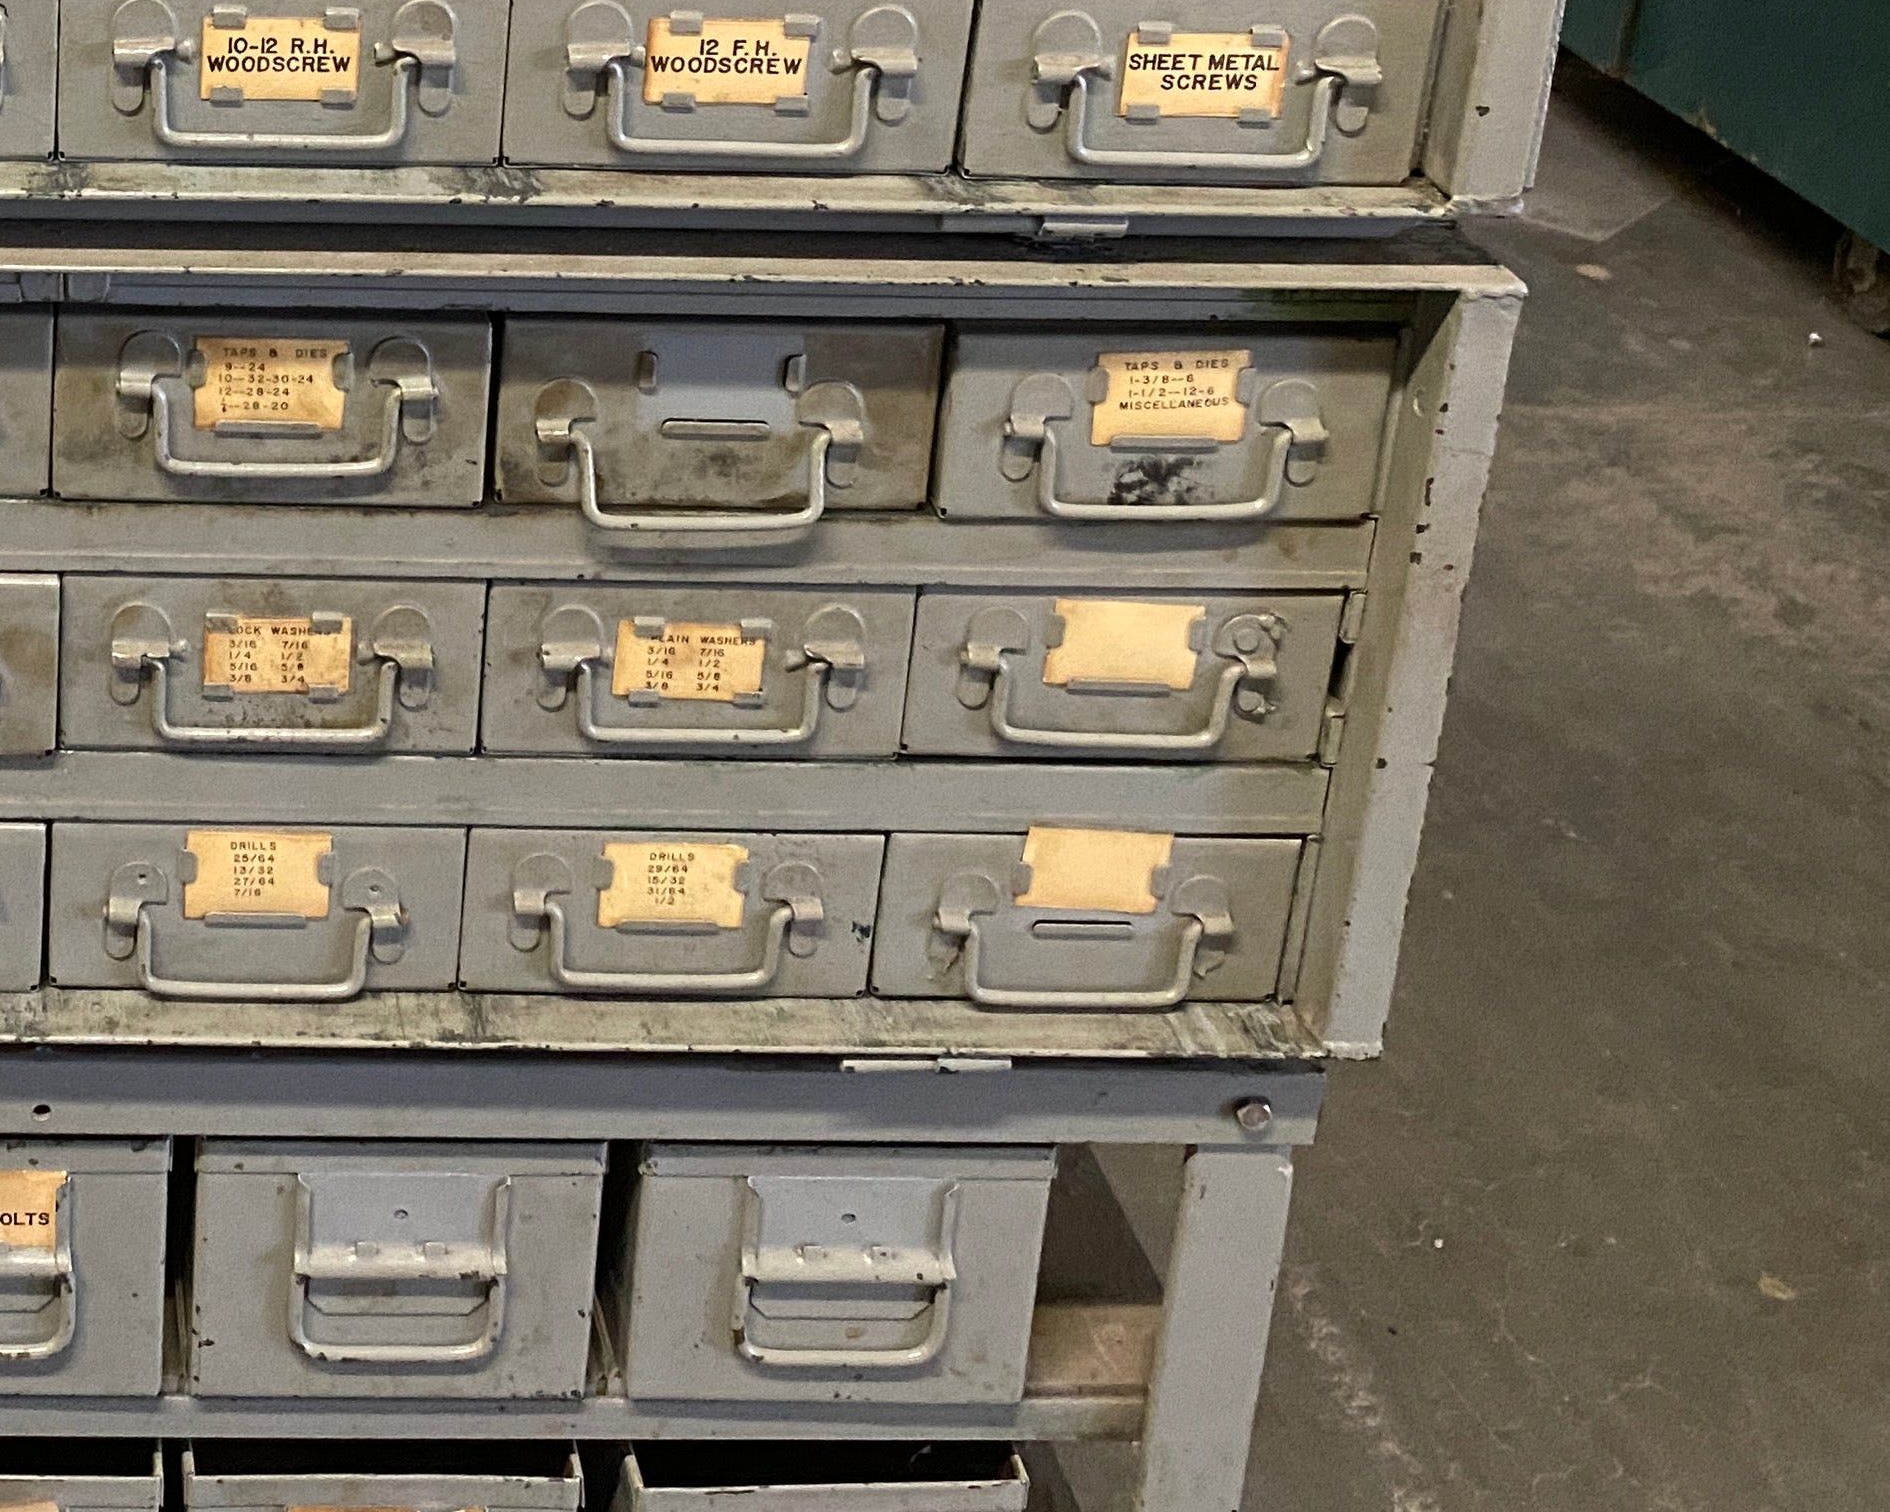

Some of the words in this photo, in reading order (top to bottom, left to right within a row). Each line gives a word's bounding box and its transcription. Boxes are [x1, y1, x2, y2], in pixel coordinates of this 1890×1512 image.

[228, 37, 278, 54] 10-12
[291, 38, 334, 54] R.H.
[700, 39, 719, 55] 12
[733, 40, 777, 56] F.H.
[207, 55, 350, 72] WOODSCREW
[651, 56, 802, 74] WOODSCREW
[1129, 54, 1202, 70] SHEET
[1208, 54, 1279, 71] METAL
[1161, 74, 1257, 90] SCREWS
[223, 347, 257, 360] TAPS
[295, 348, 328, 359] DIES
[1124, 361, 1159, 371] TAPS
[1195, 359, 1229, 369] DIES
[1119, 395, 1228, 410] MISCELLANEOUS
[232, 624, 262, 637] OCK
[230, 841, 276, 851] DRILLS
[650, 852, 694, 863] DRILLS
